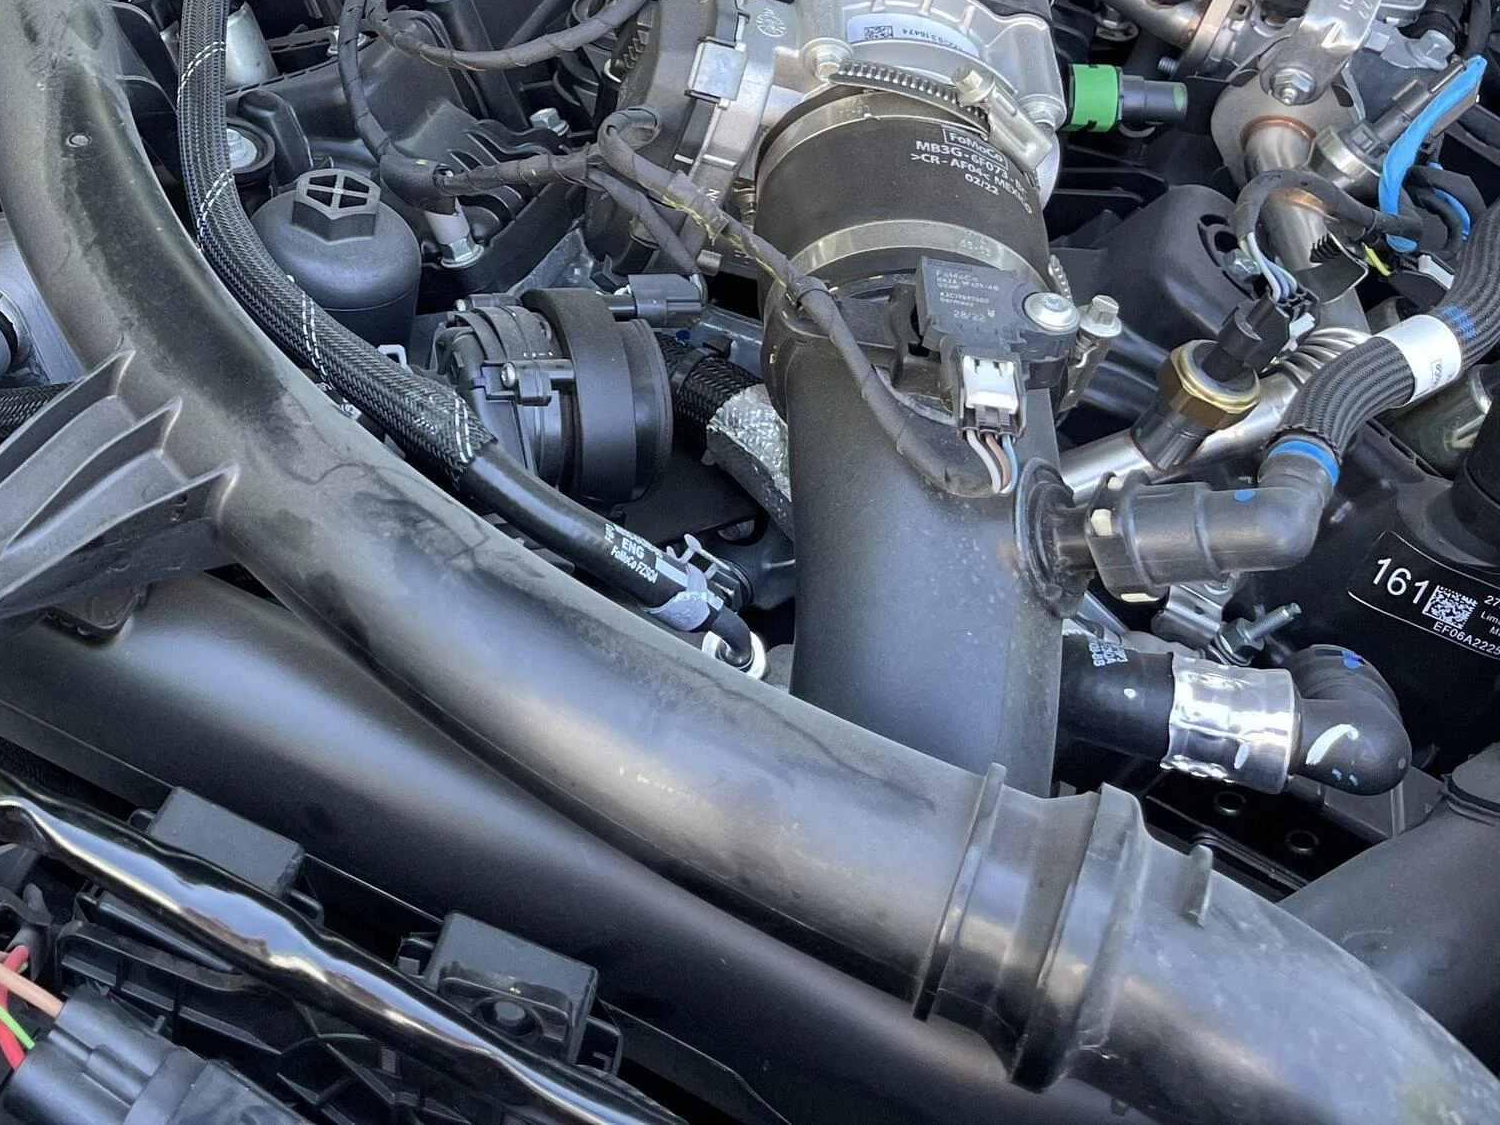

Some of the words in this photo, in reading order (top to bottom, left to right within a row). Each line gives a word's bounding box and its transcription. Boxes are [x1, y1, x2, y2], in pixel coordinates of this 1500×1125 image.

[949, 132, 1004, 163] FoMoCo
[936, 270, 979, 283] FoMoCo
[622, 536, 645, 560] ENG
[1373, 557, 1430, 605] 161
